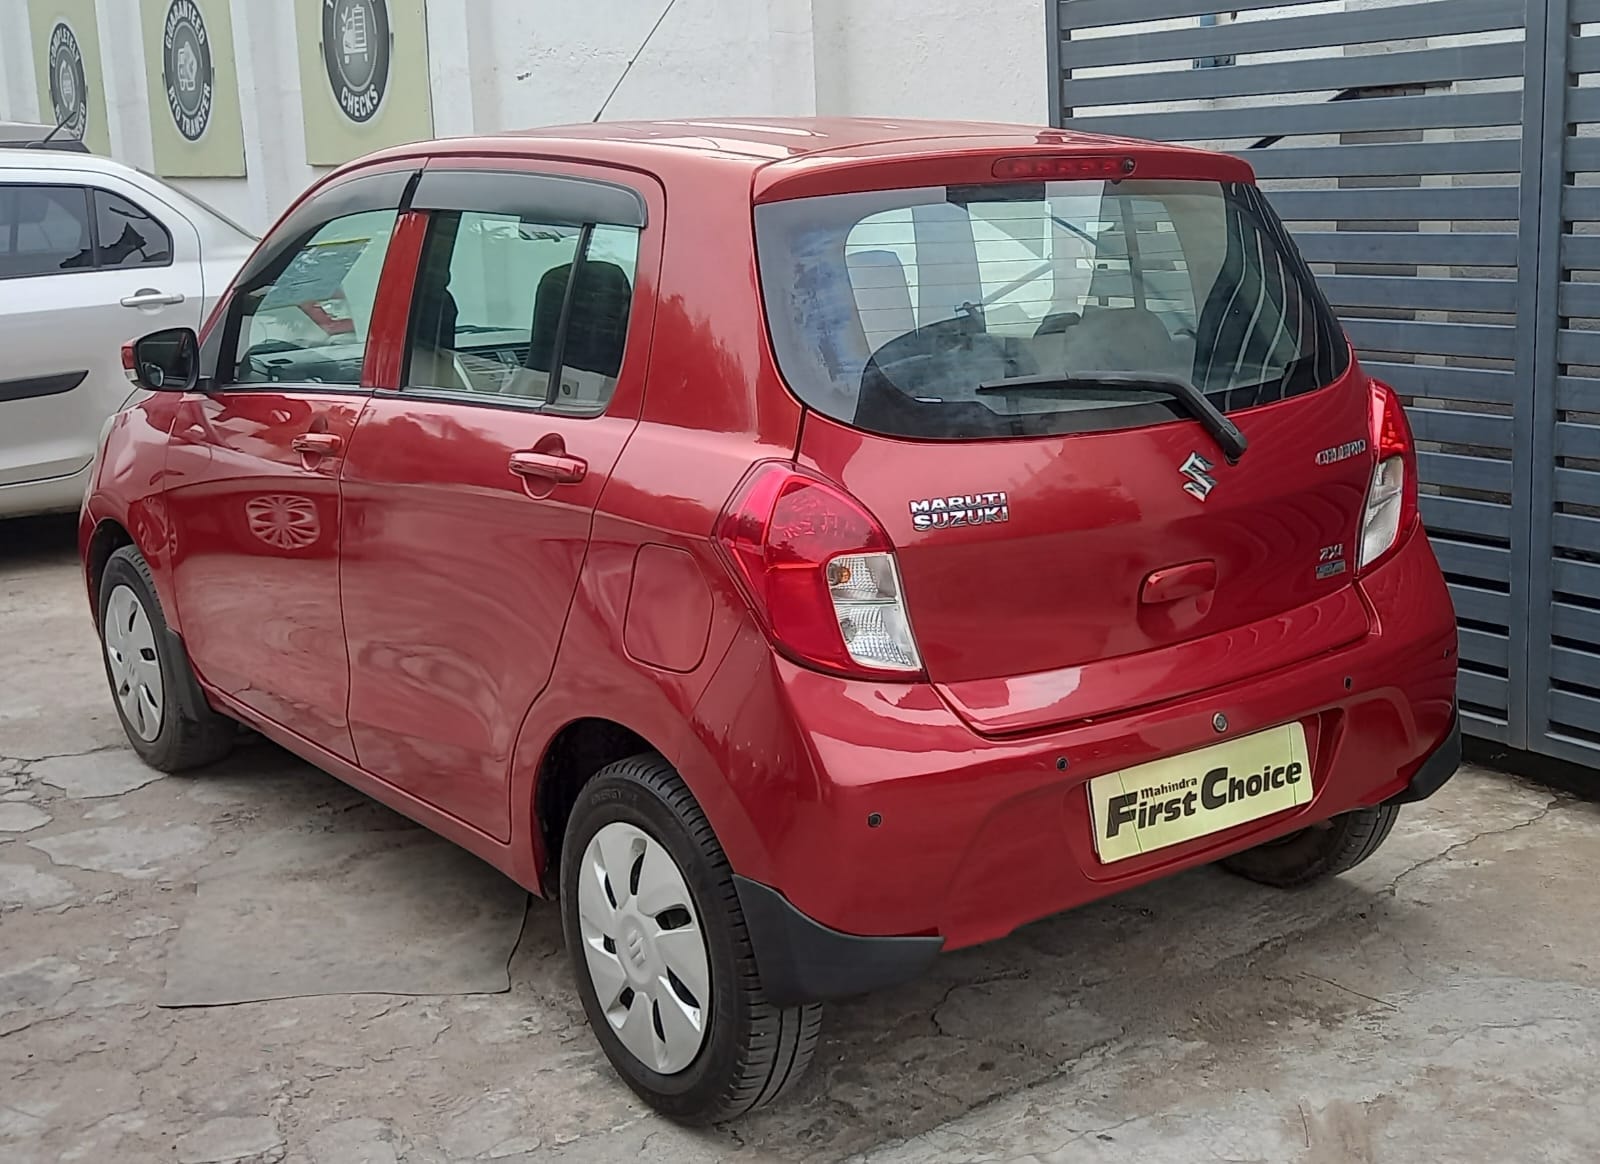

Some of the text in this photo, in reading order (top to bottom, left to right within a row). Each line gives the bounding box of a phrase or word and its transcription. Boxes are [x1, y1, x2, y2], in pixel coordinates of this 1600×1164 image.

[165, 1, 205, 49] GUARANTEED
[50, 27, 80, 68] COMPLETELY
[181, 83, 211, 137] TRANSFER
[341, 84, 379, 117] CHECKS
[909, 492, 1007, 514] MARUTI
[913, 506, 1009, 531] SUZUKI
[1106, 761, 1302, 838] First Choice
[1141, 777, 1197, 799] Mahindra
